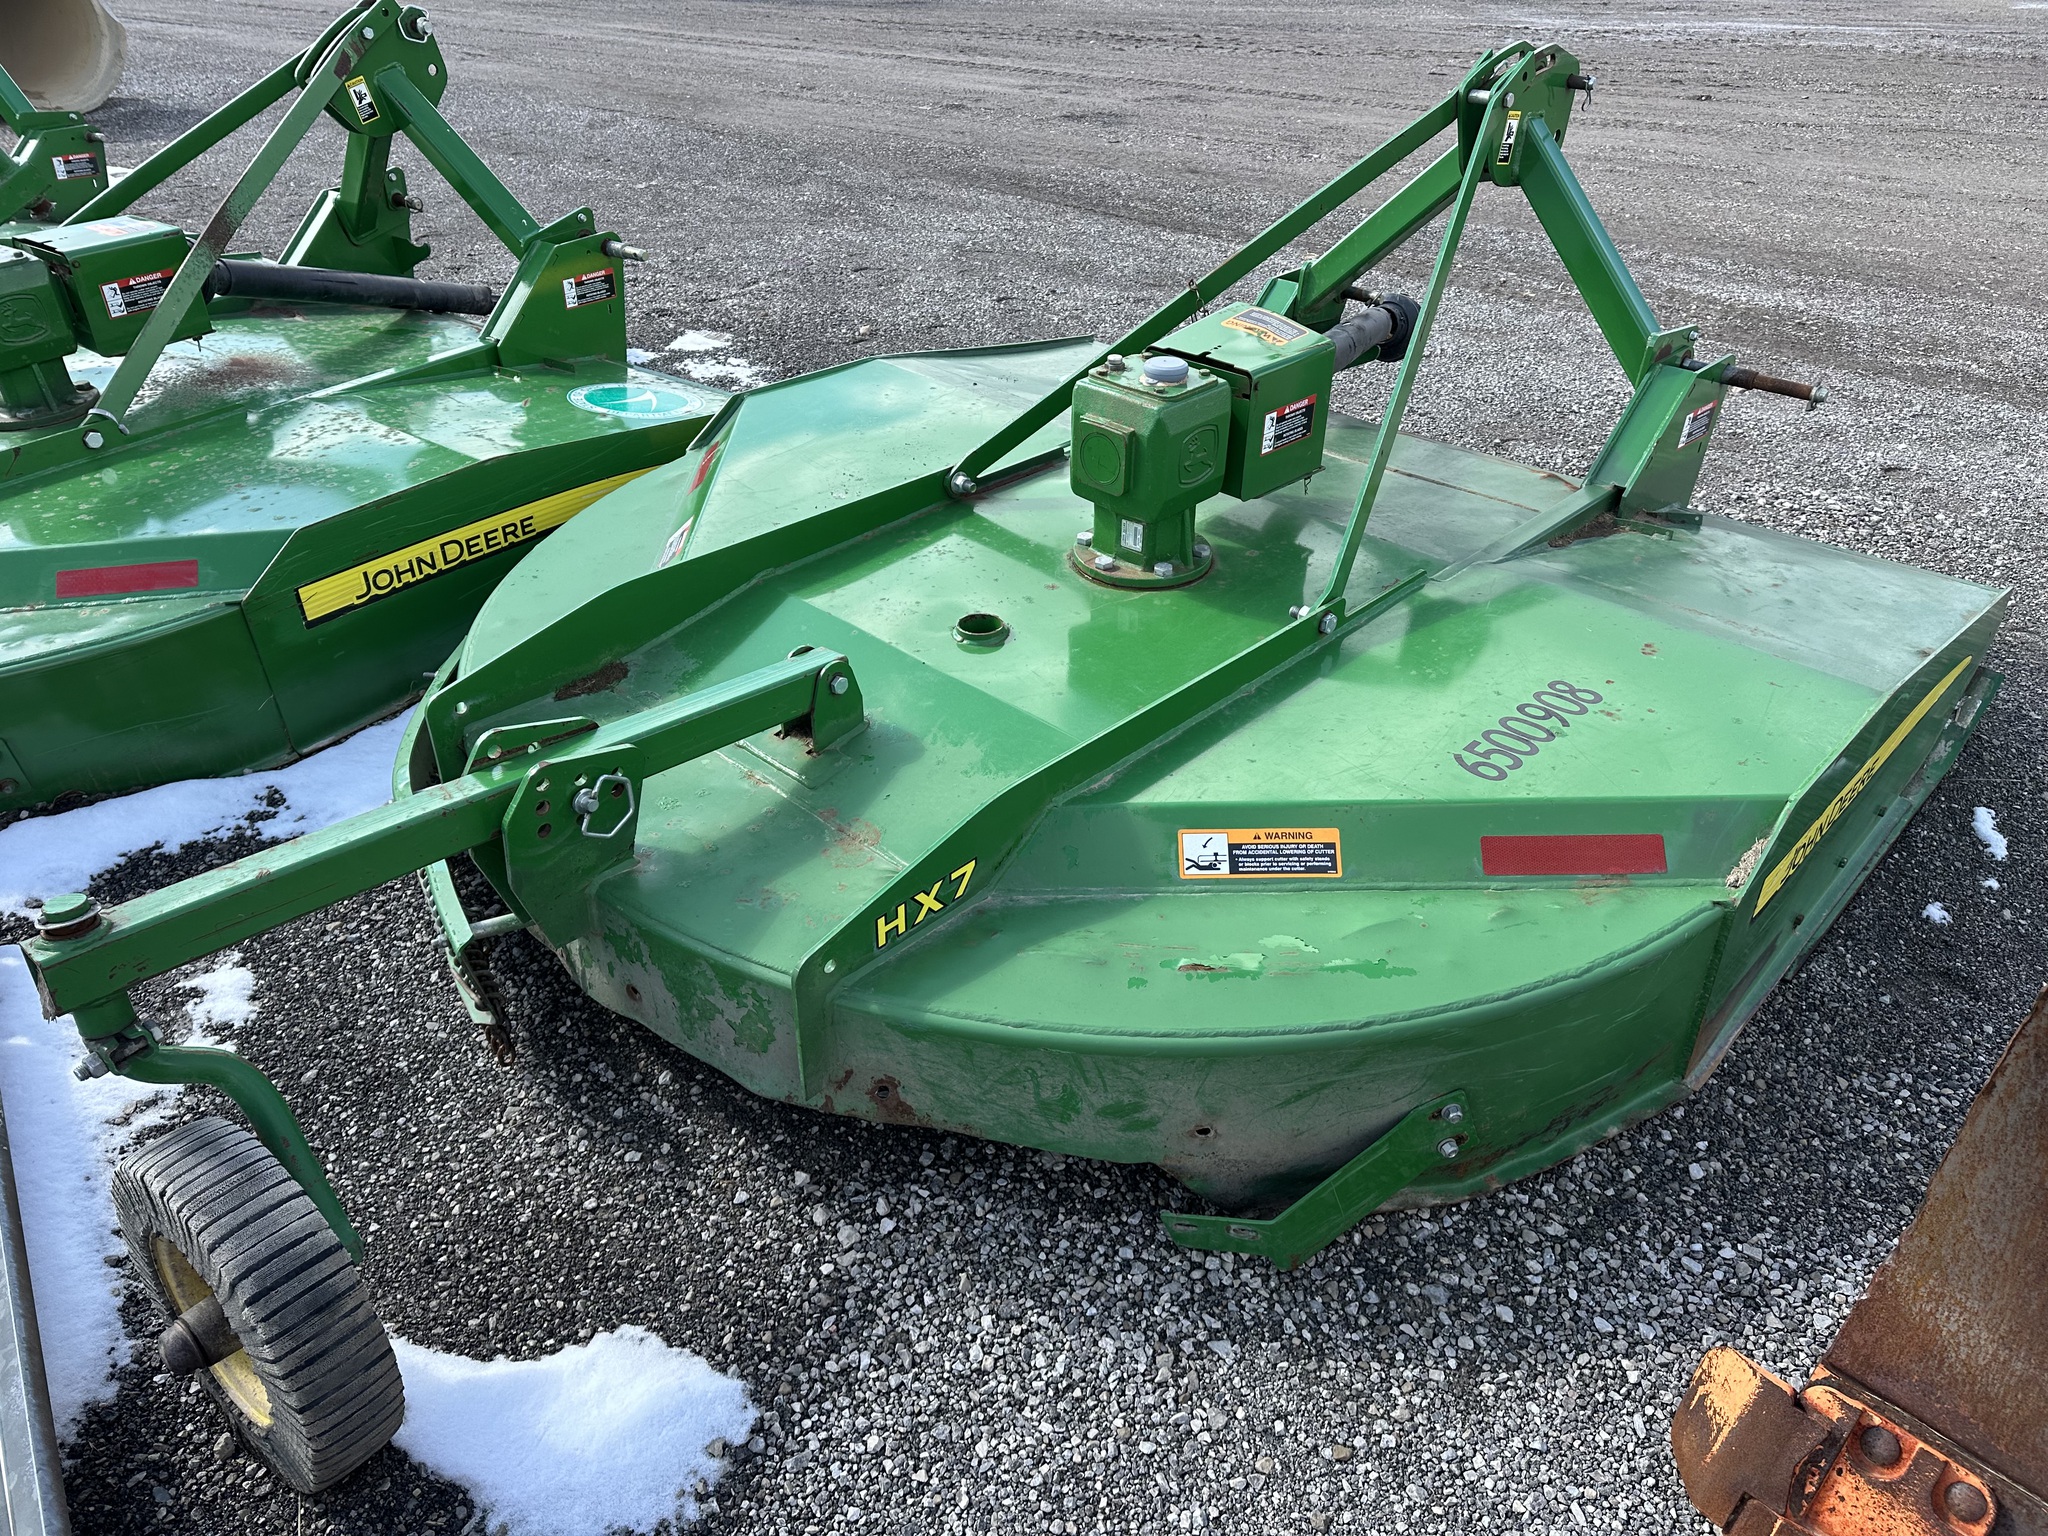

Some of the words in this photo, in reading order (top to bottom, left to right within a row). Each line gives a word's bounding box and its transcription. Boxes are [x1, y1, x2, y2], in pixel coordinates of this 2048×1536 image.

[136, 273, 162, 283] DANGER
[586, 270, 605, 279] DANGER
[1290, 399, 1309, 411] DANGER
[355, 551, 437, 600] JOHN
[439, 515, 537, 566] DEERE
[1453, 680, 1603, 781] 6500908
[1264, 832, 1313, 840] WARNING
[1780, 815, 1830, 884] JOHN
[1826, 757, 1880, 829] DEERE
[876, 857, 977, 949] HX7
